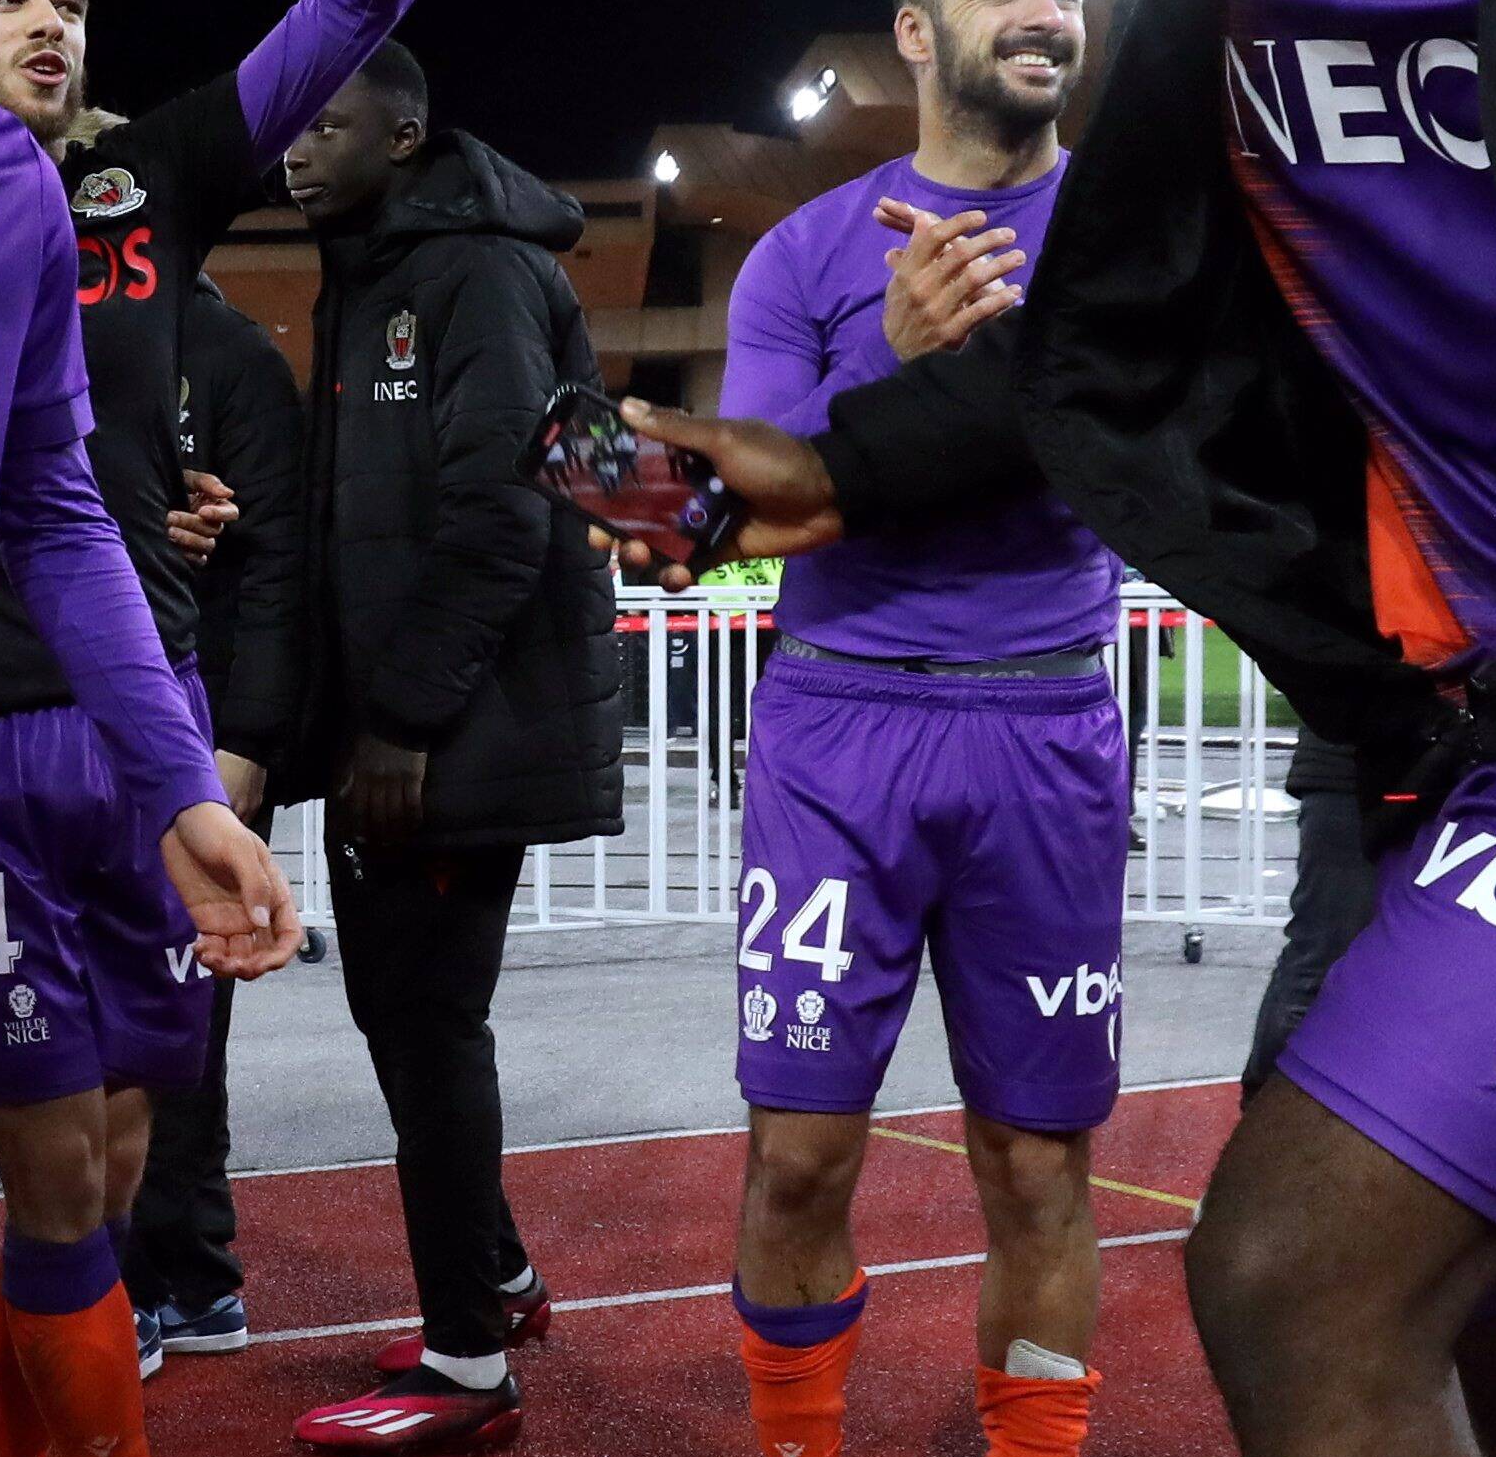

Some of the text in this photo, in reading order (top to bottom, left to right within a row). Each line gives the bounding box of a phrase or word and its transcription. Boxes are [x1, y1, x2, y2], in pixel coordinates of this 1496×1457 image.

[1224, 37, 1492, 170] NEO
[738, 866, 854, 982] 24
[4, 1019, 33, 1032] VILLE
[786, 1023, 815, 1036] VILLE
[6, 1026, 51, 1046] NICE
[786, 1034, 831, 1052] NICE
